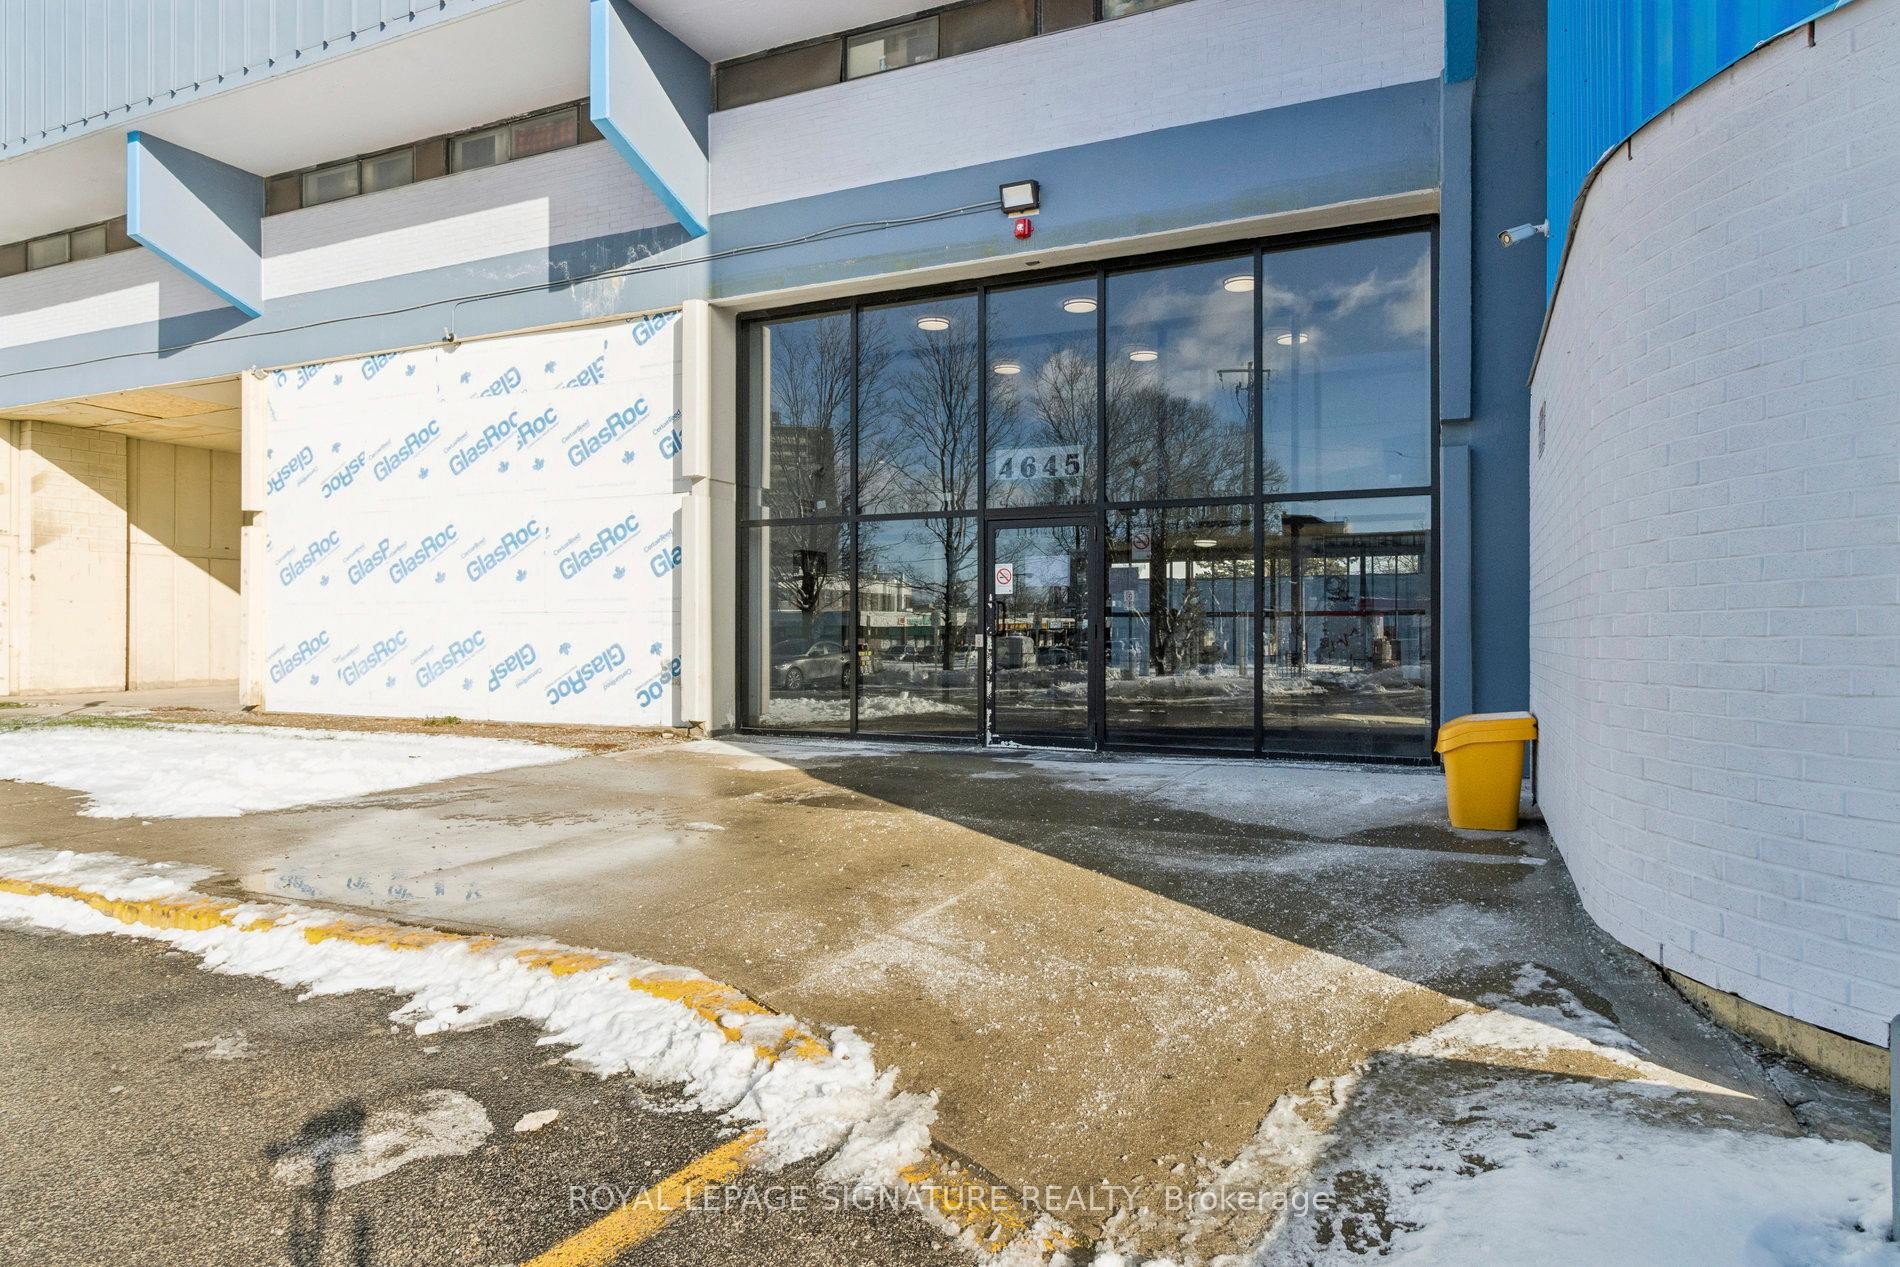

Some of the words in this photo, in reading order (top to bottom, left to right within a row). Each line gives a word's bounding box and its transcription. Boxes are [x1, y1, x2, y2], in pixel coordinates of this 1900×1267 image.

[373, 419, 440, 482] GlasRoc
[448, 411, 518, 476] GlasRoc
[567, 398, 648, 467] GlasRoc
[1000, 453, 1080, 478] 4645
[279, 530, 340, 587] GlasRoc
[389, 523, 457, 584] GlasRoc
[466, 519, 540, 582] GlasRoc
[559, 514, 640, 580] GlasRoc
[269, 630, 330, 684] GlasRoc
[342, 630, 408, 686] GlasRoc
[415, 630, 485, 689] GlasRoc
[546, 643, 626, 705] GlasRoc
